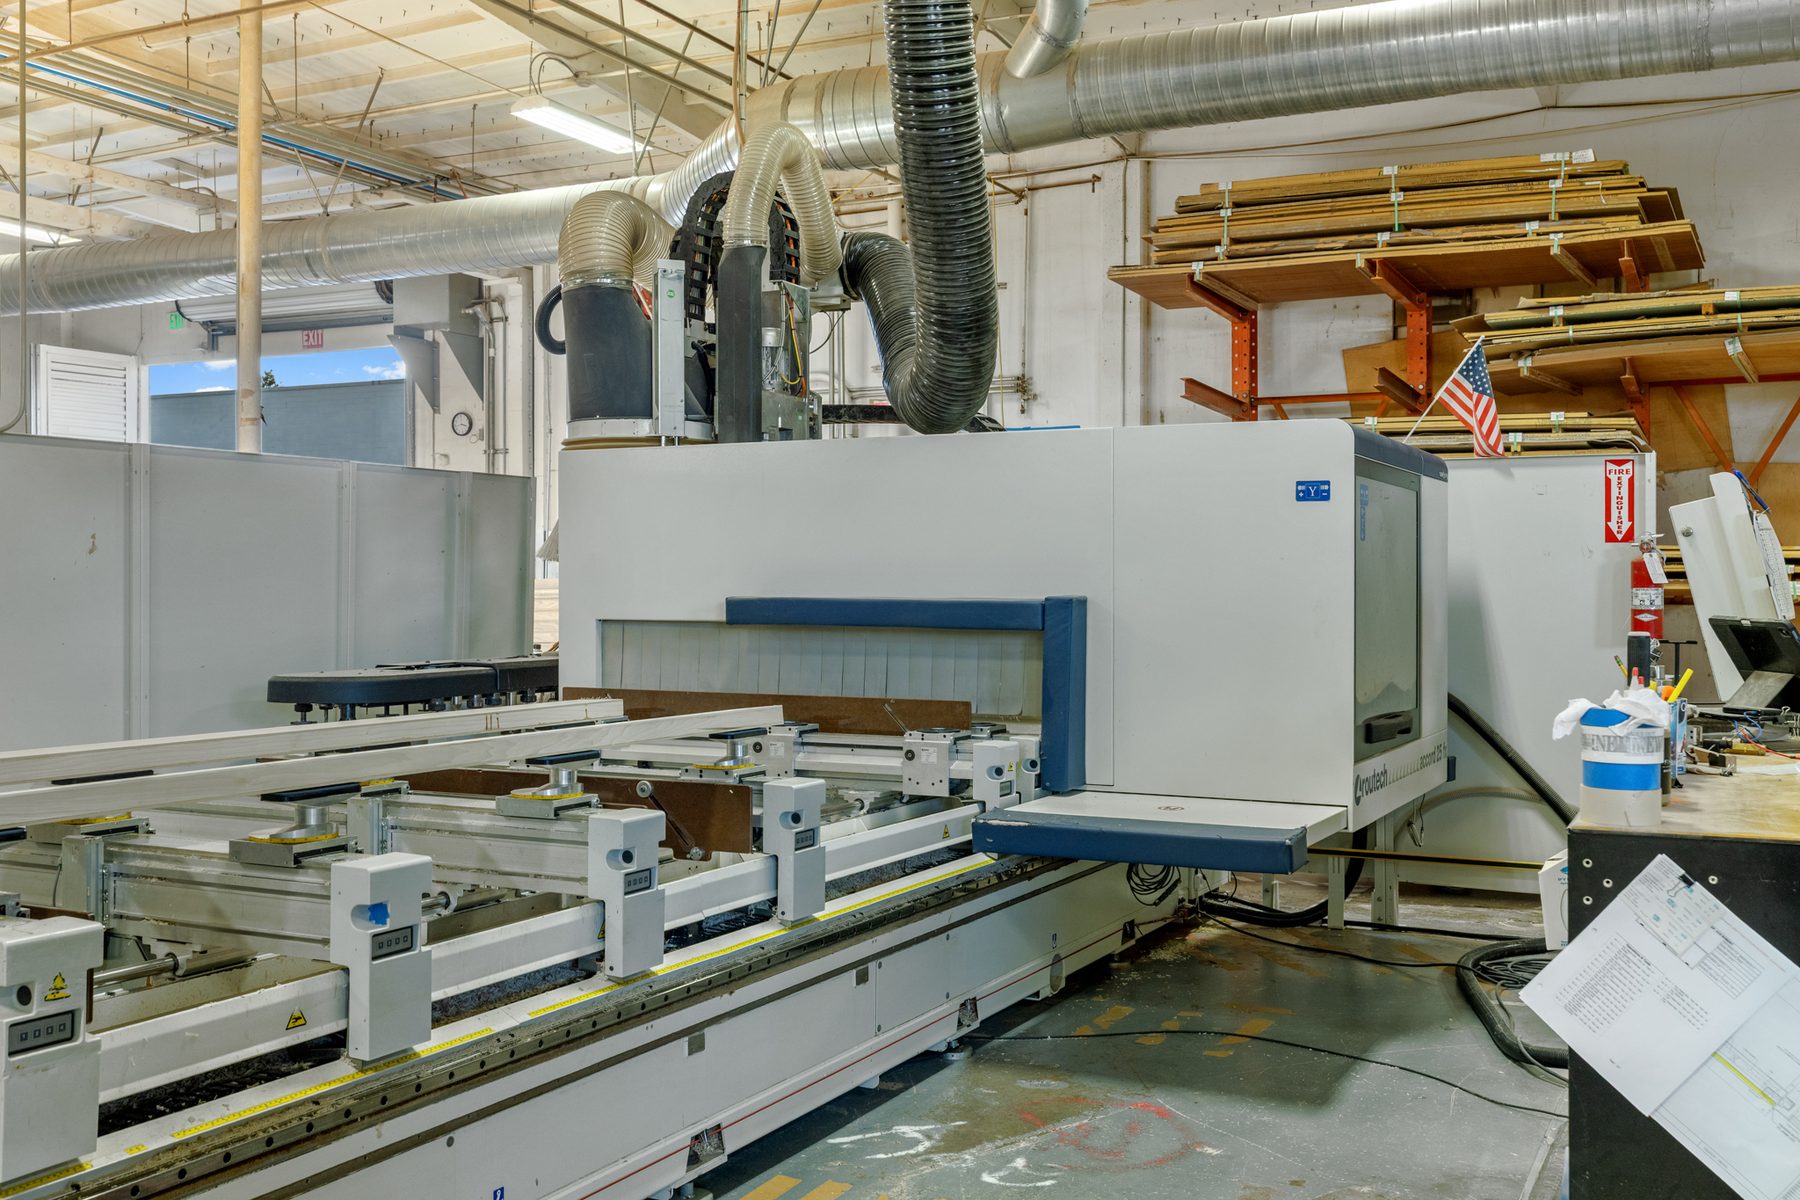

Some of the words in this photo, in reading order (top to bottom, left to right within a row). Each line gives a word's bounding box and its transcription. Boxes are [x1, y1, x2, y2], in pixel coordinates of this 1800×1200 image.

[303, 330, 322, 345] EXIT
[1608, 468, 1631, 476] FIRE
[1616, 476, 1624, 535] EXTINGUISHER
[1360, 763, 1388, 798] routech
